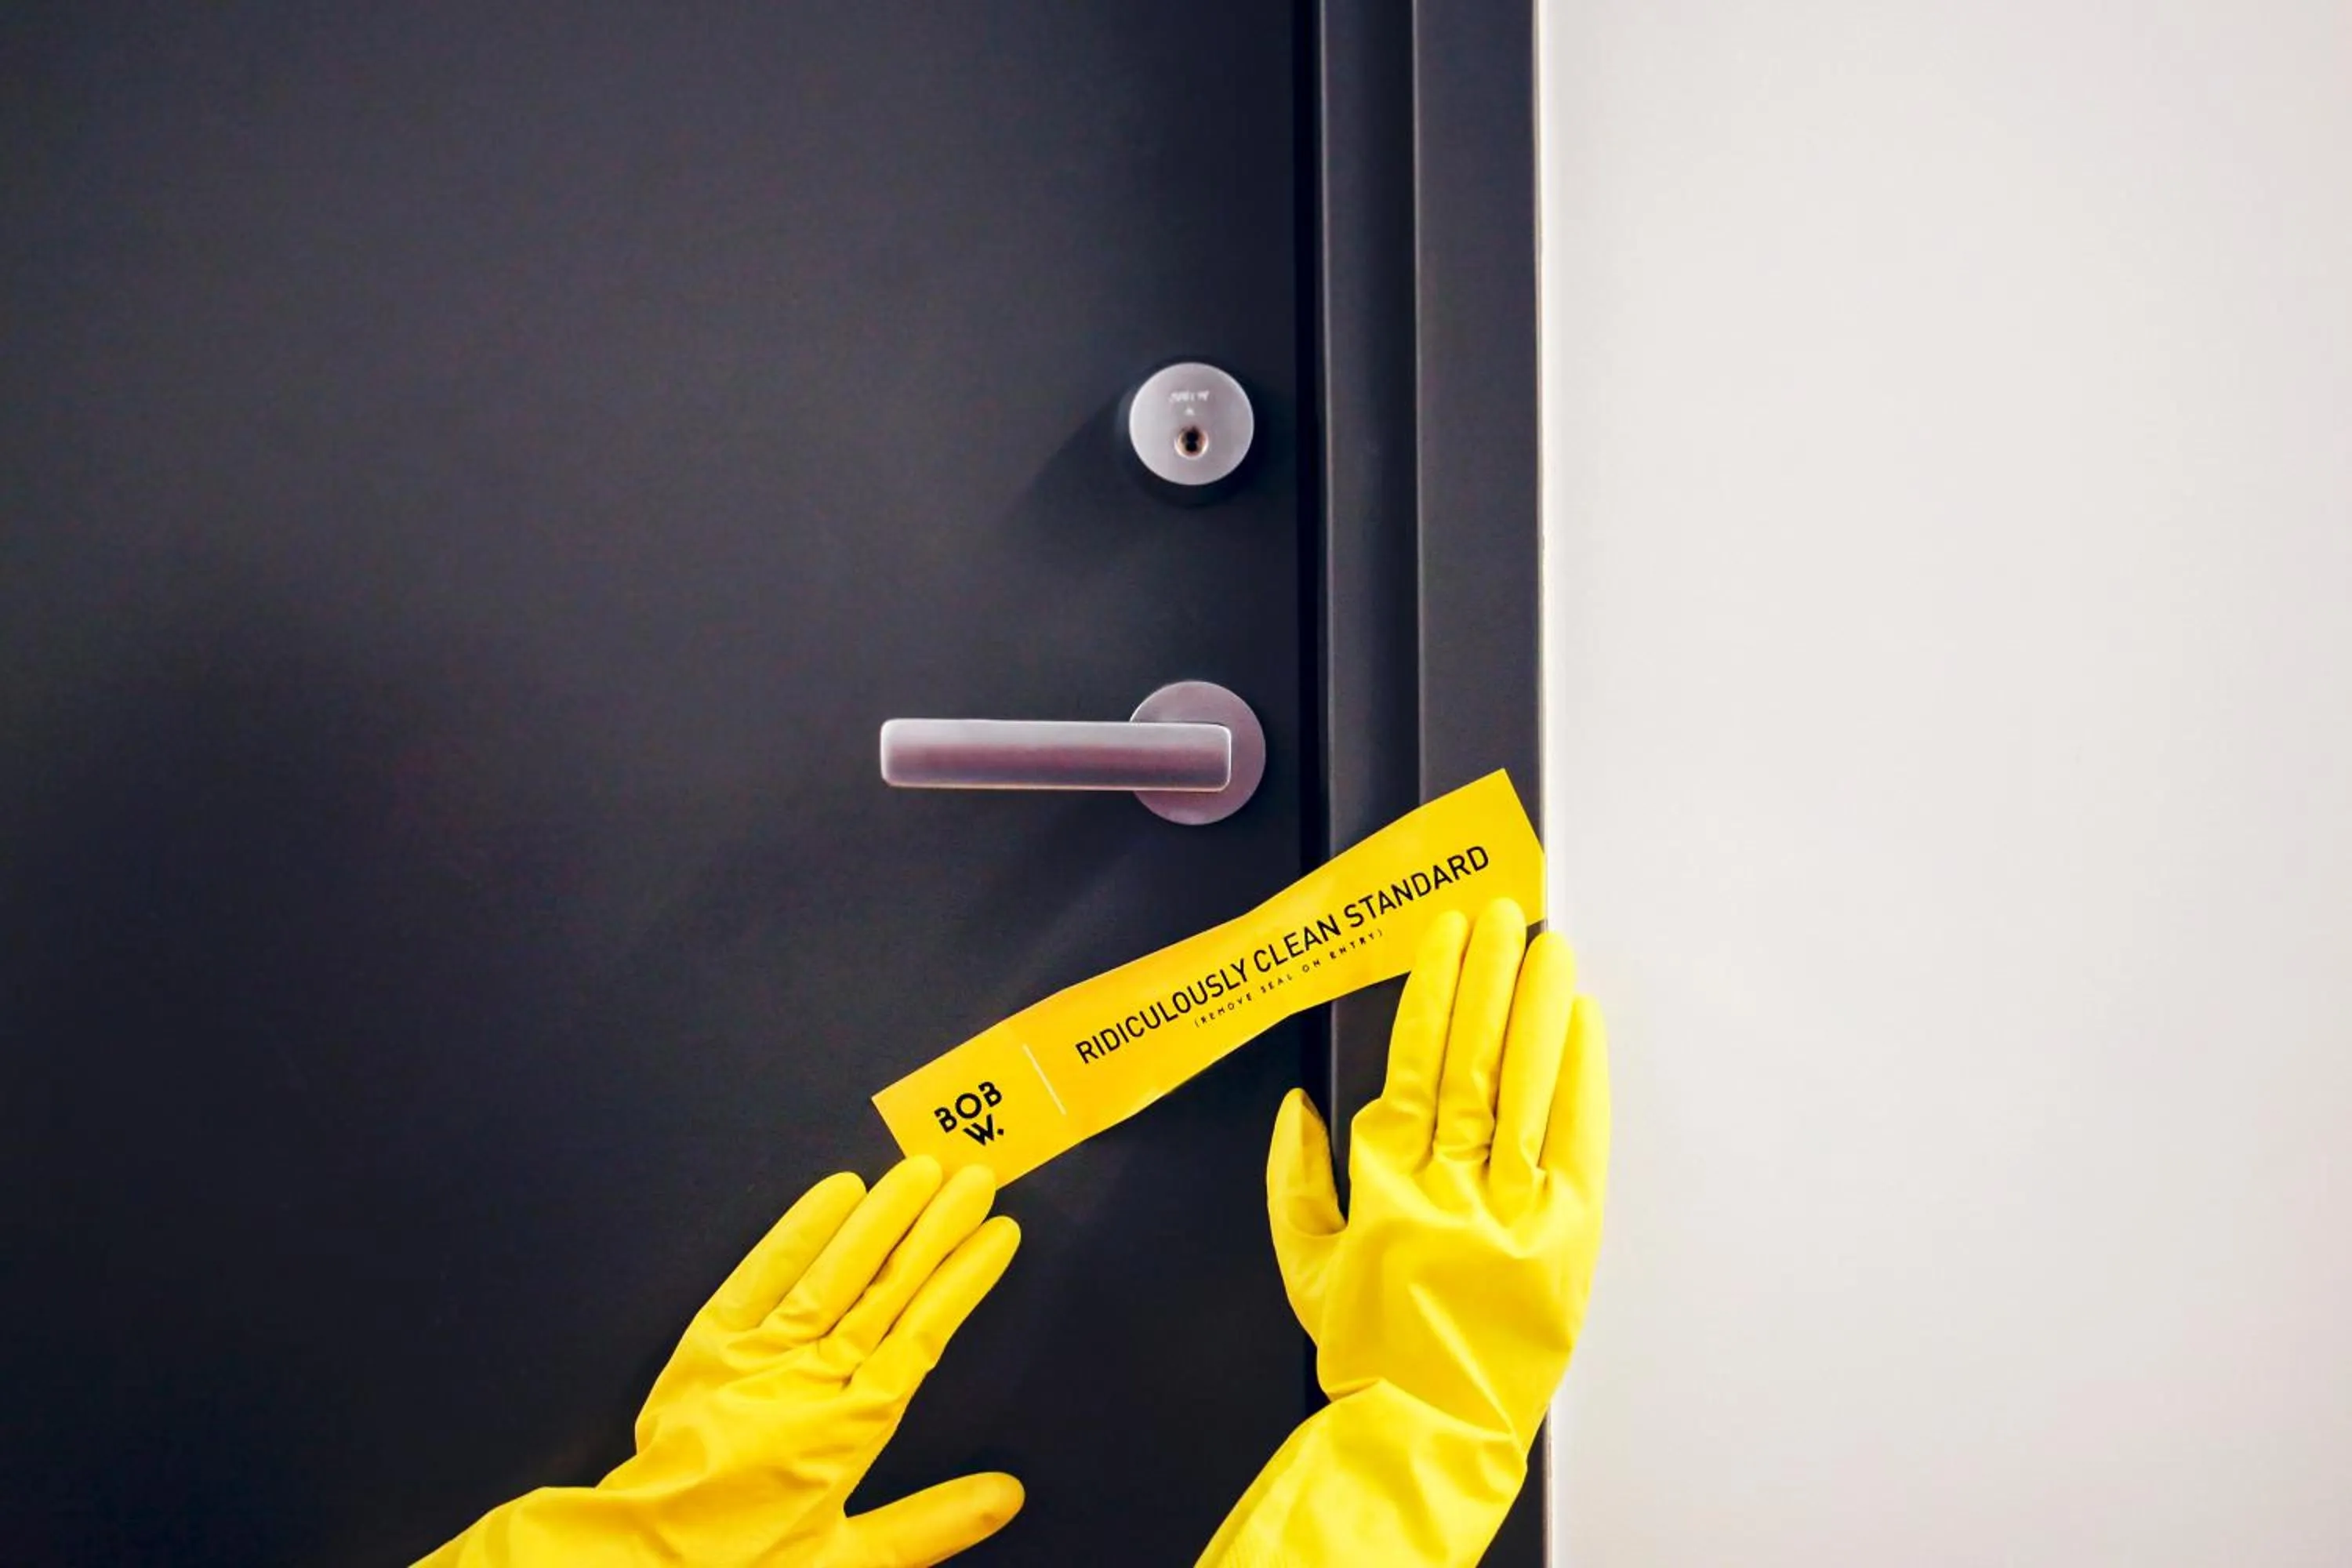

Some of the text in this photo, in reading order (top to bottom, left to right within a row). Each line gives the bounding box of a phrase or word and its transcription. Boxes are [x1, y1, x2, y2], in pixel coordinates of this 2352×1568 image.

[1076, 845, 1489, 1064] RIDICULOUSLY CLEAN STANDARD
[1194, 929, 1382, 1029] (REMOVE SEAL ON ENTRY)
[934, 1081, 1002, 1133] BOB
[963, 1113, 1004, 1146] W.
